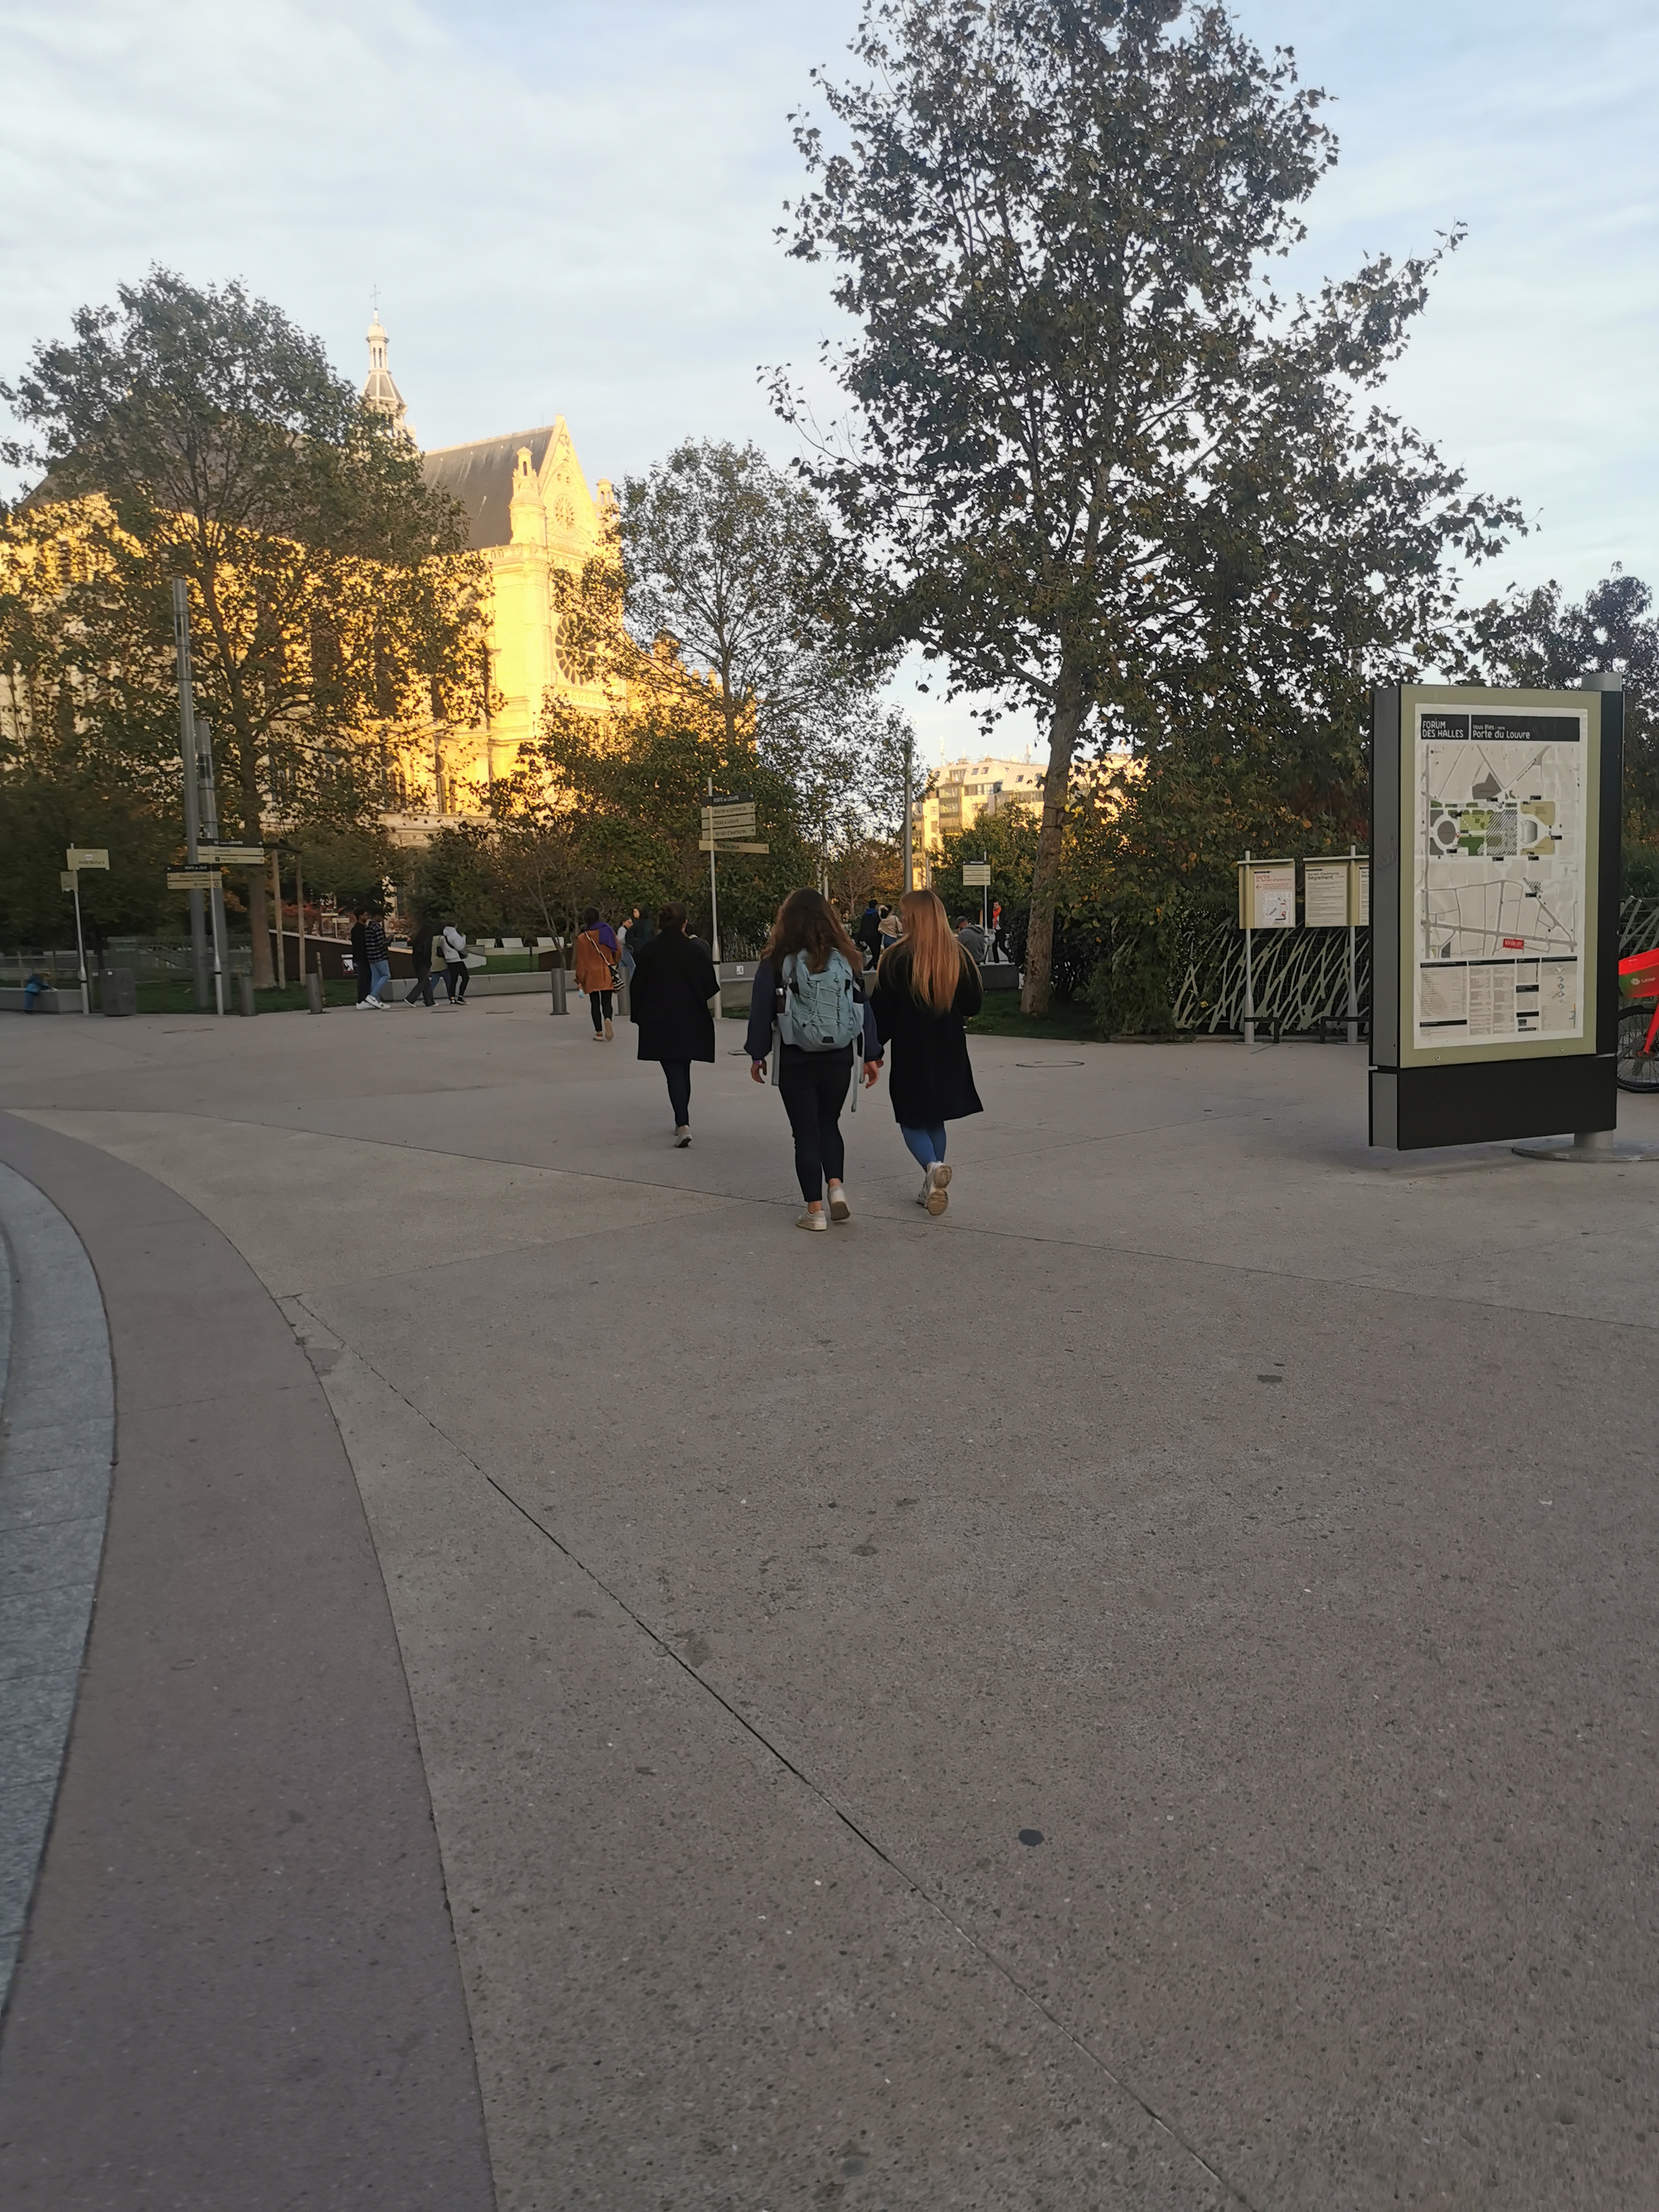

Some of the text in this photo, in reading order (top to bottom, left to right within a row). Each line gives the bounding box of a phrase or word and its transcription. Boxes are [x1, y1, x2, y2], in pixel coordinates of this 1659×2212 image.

[1423, 720, 1446, 729] FORUM
[1422, 729, 1464, 738] DES HALLES
[1473, 730, 1530, 739] Porte du Louvre
